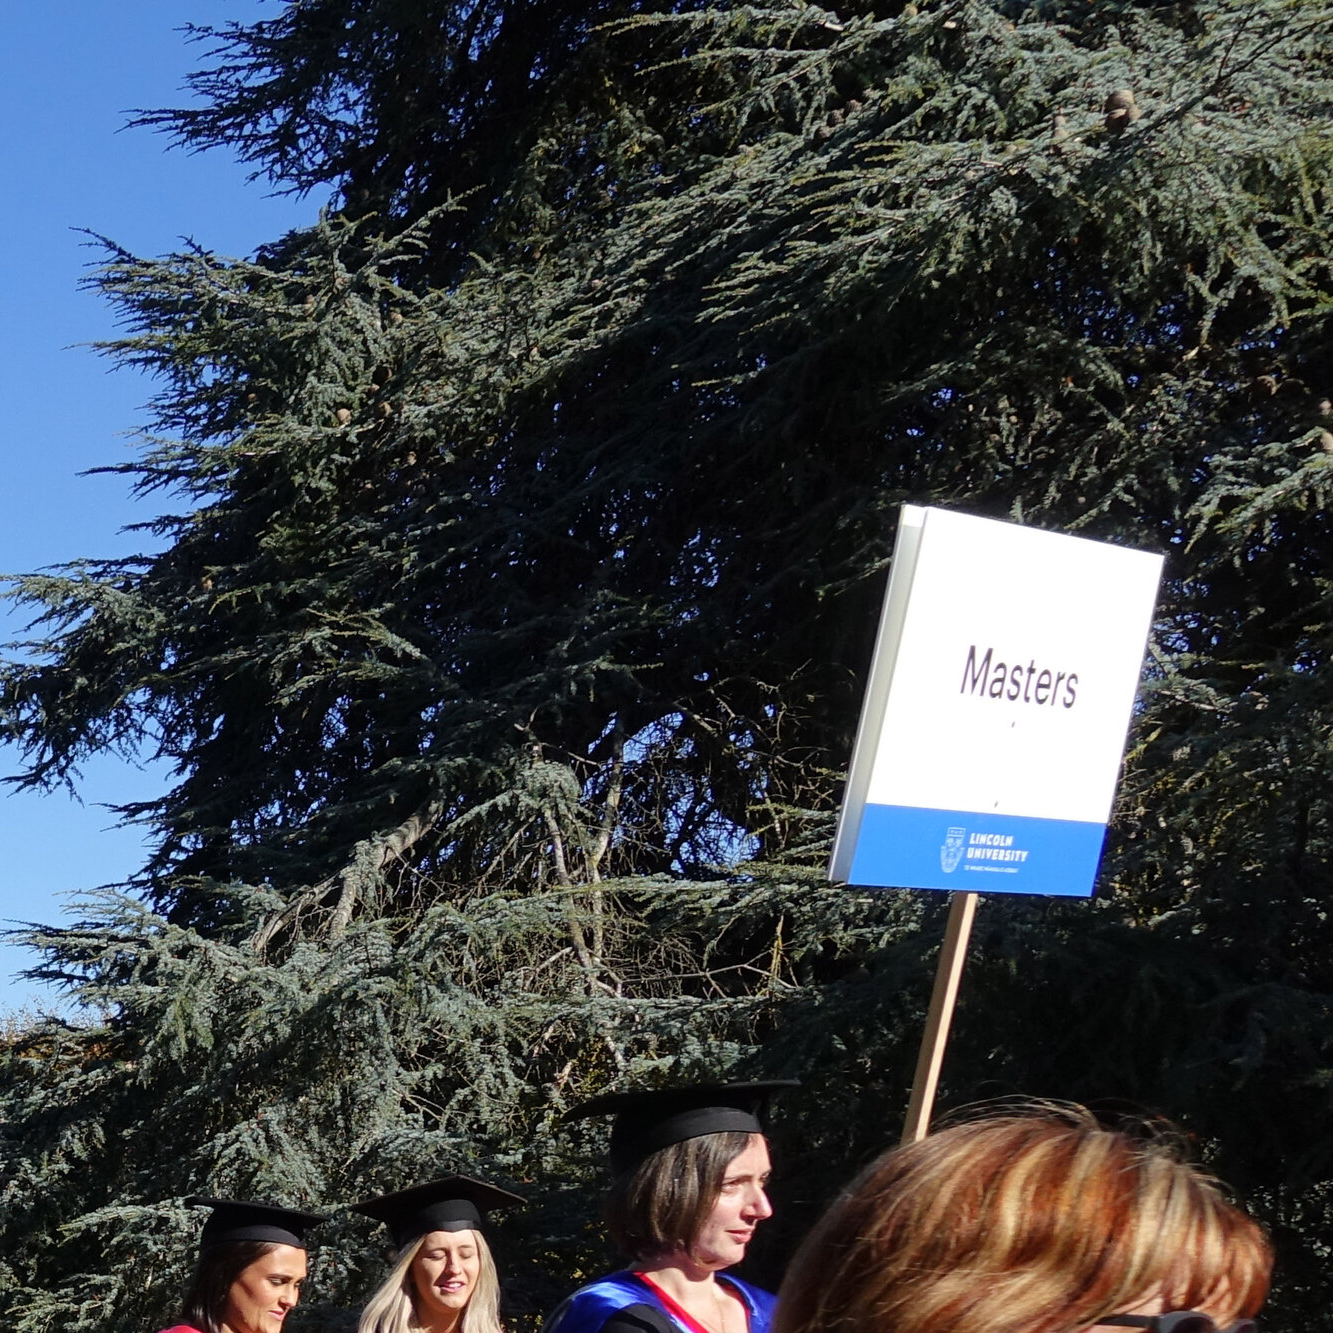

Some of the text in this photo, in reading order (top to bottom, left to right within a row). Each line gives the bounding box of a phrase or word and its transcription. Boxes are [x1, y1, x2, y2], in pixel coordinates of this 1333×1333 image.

[960, 645, 1079, 708] Masters
[969, 833, 1014, 847] LINCOLN
[967, 847, 1029, 862] UNIVERSITY
